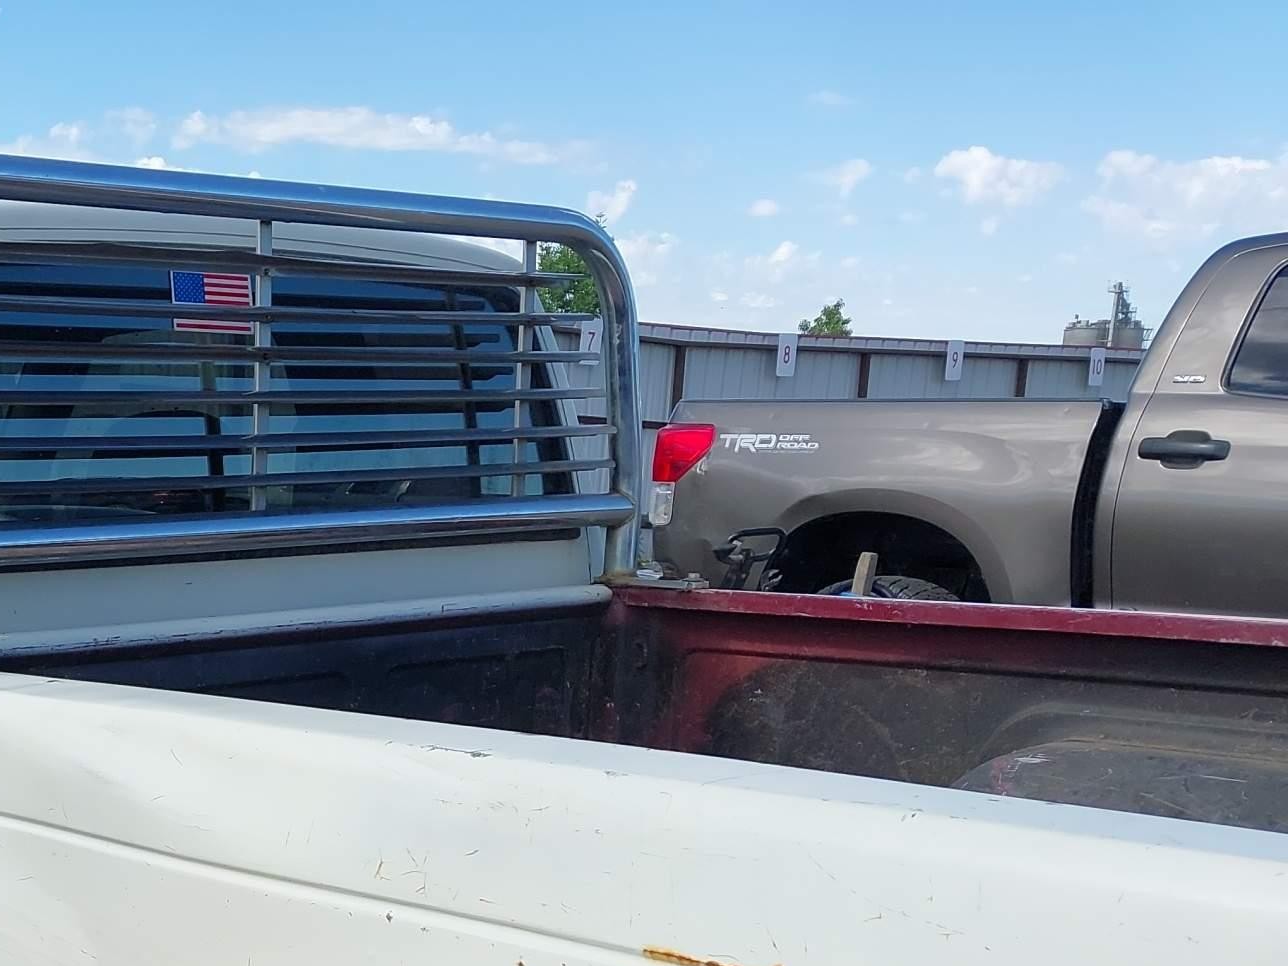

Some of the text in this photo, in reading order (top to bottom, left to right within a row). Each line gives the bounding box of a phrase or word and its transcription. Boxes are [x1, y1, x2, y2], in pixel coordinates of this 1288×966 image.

[587, 330, 596, 351] 7
[783, 344, 791, 364] 8
[952, 351, 959, 368] 9
[1092, 358, 1103, 375] 10
[719, 433, 777, 453] TRD
